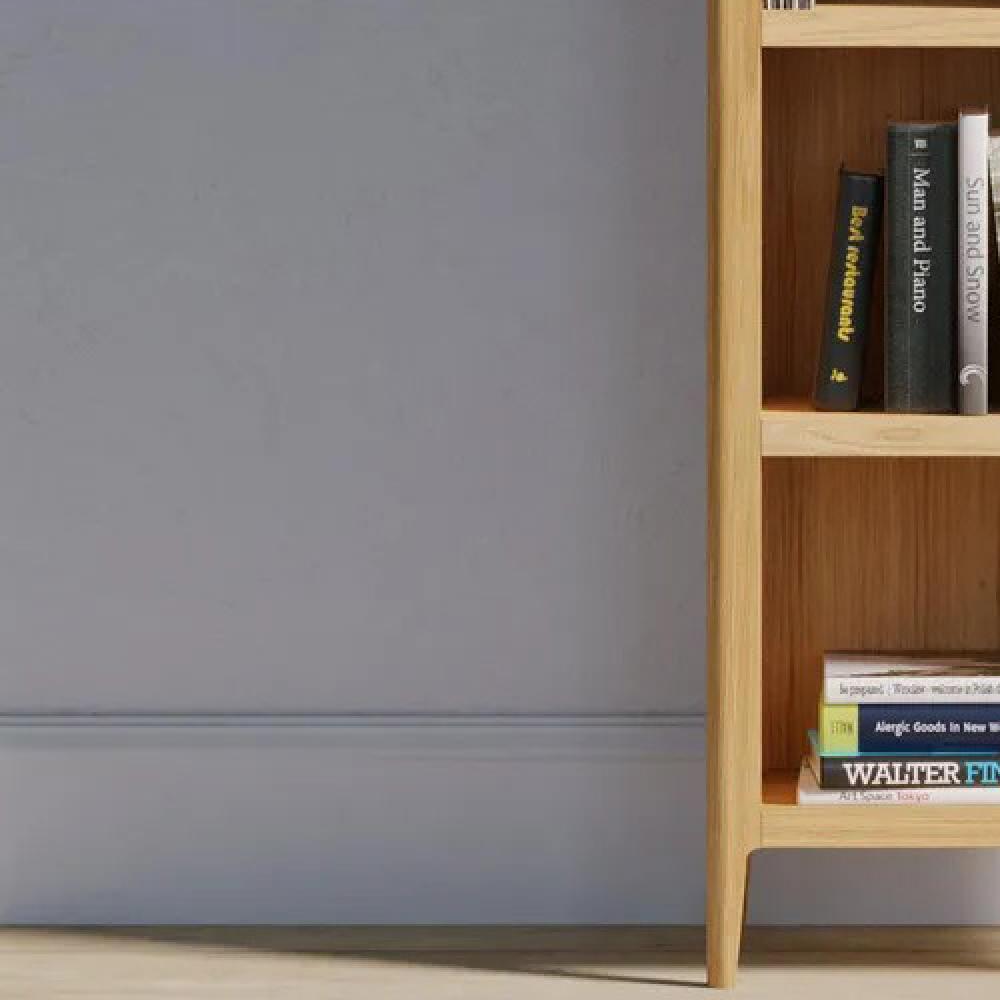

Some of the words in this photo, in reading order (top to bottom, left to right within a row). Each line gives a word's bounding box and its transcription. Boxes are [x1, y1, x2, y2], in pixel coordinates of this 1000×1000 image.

[913, 167, 931, 211] Man
[967, 177, 985, 216] Sun
[913, 217, 933, 253] and
[967, 221, 985, 260] and
[913, 259, 931, 313] Piano
[967, 265, 985, 323] Snow
[913, 720, 947, 733] Goods
[963, 721, 987, 733] New
[842, 762, 961, 785] WALTER
[896, 791, 931, 804] Tokyo
